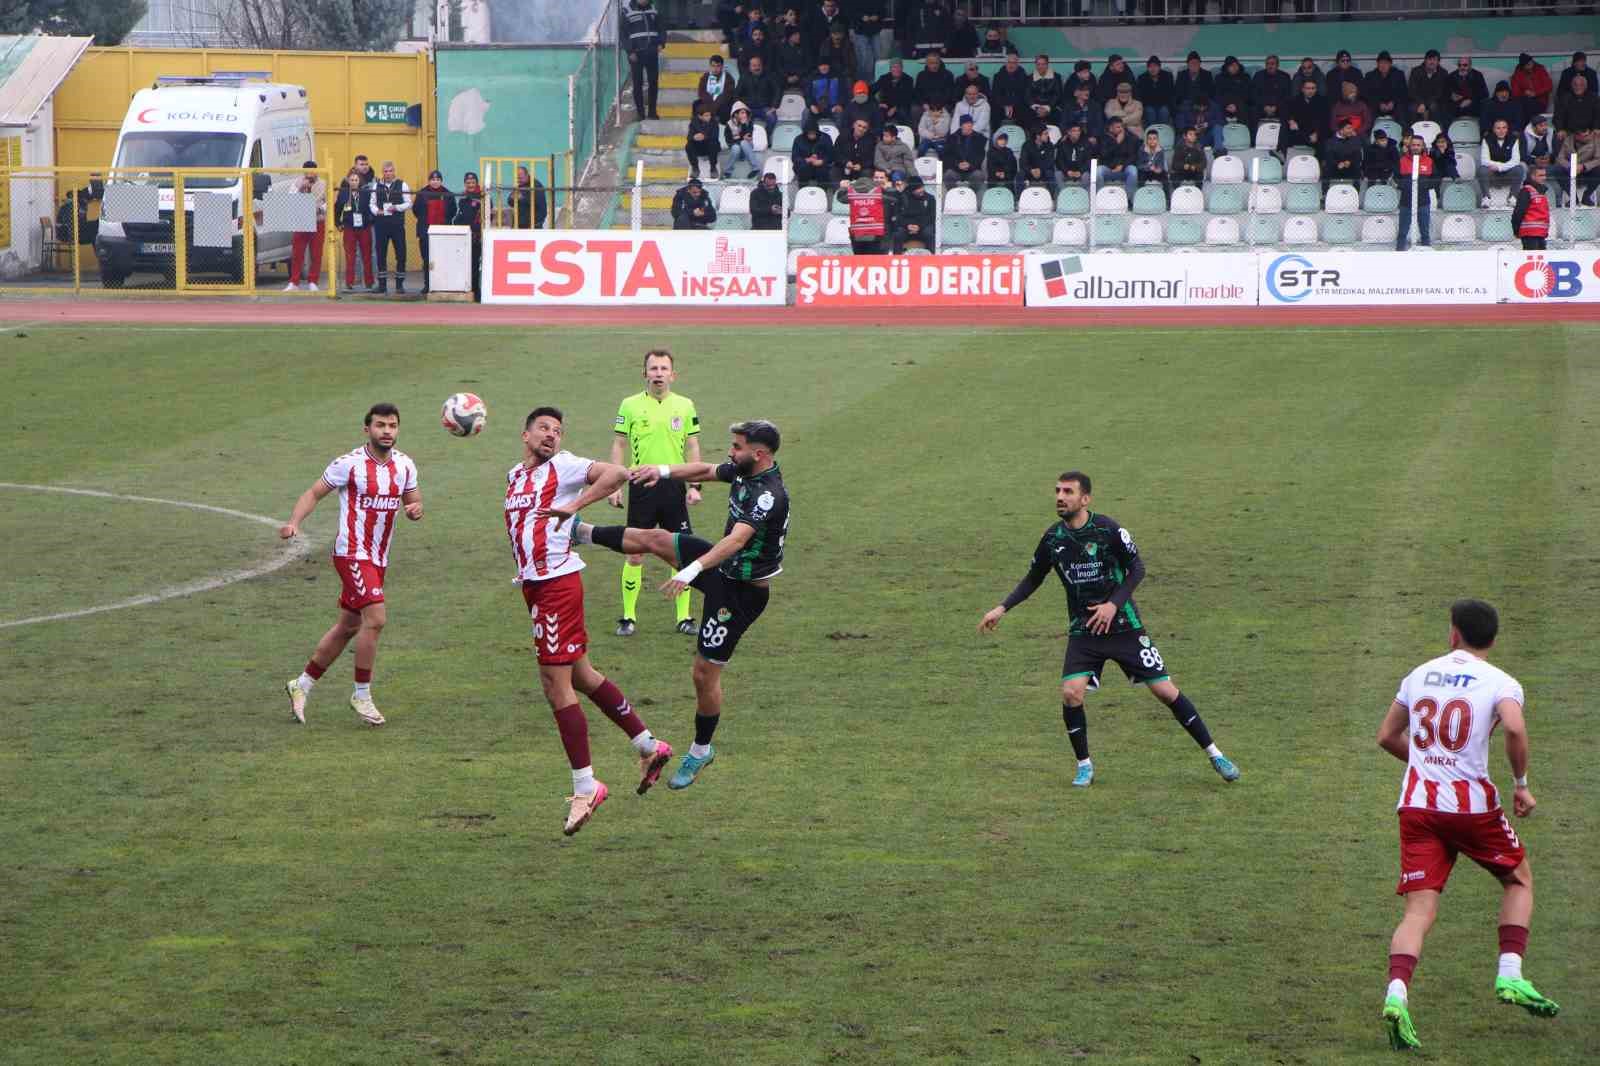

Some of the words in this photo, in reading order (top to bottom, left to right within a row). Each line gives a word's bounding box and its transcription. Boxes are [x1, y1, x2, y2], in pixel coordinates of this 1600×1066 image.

[492, 239, 677, 297] ESTA
[681, 271, 777, 302] İNŞAAT
[800, 259, 910, 304] ŞÜKRÜ
[920, 258, 1021, 295] DERİCİ
[1279, 270, 1341, 287] STR
[1073, 276, 1184, 299] albamar
[1189, 283, 1244, 299] marble
[1315, 287, 1330, 296] STR
[703, 617, 728, 647] 58
[1140, 646, 1164, 668] 88
[1412, 695, 1474, 754] 30
